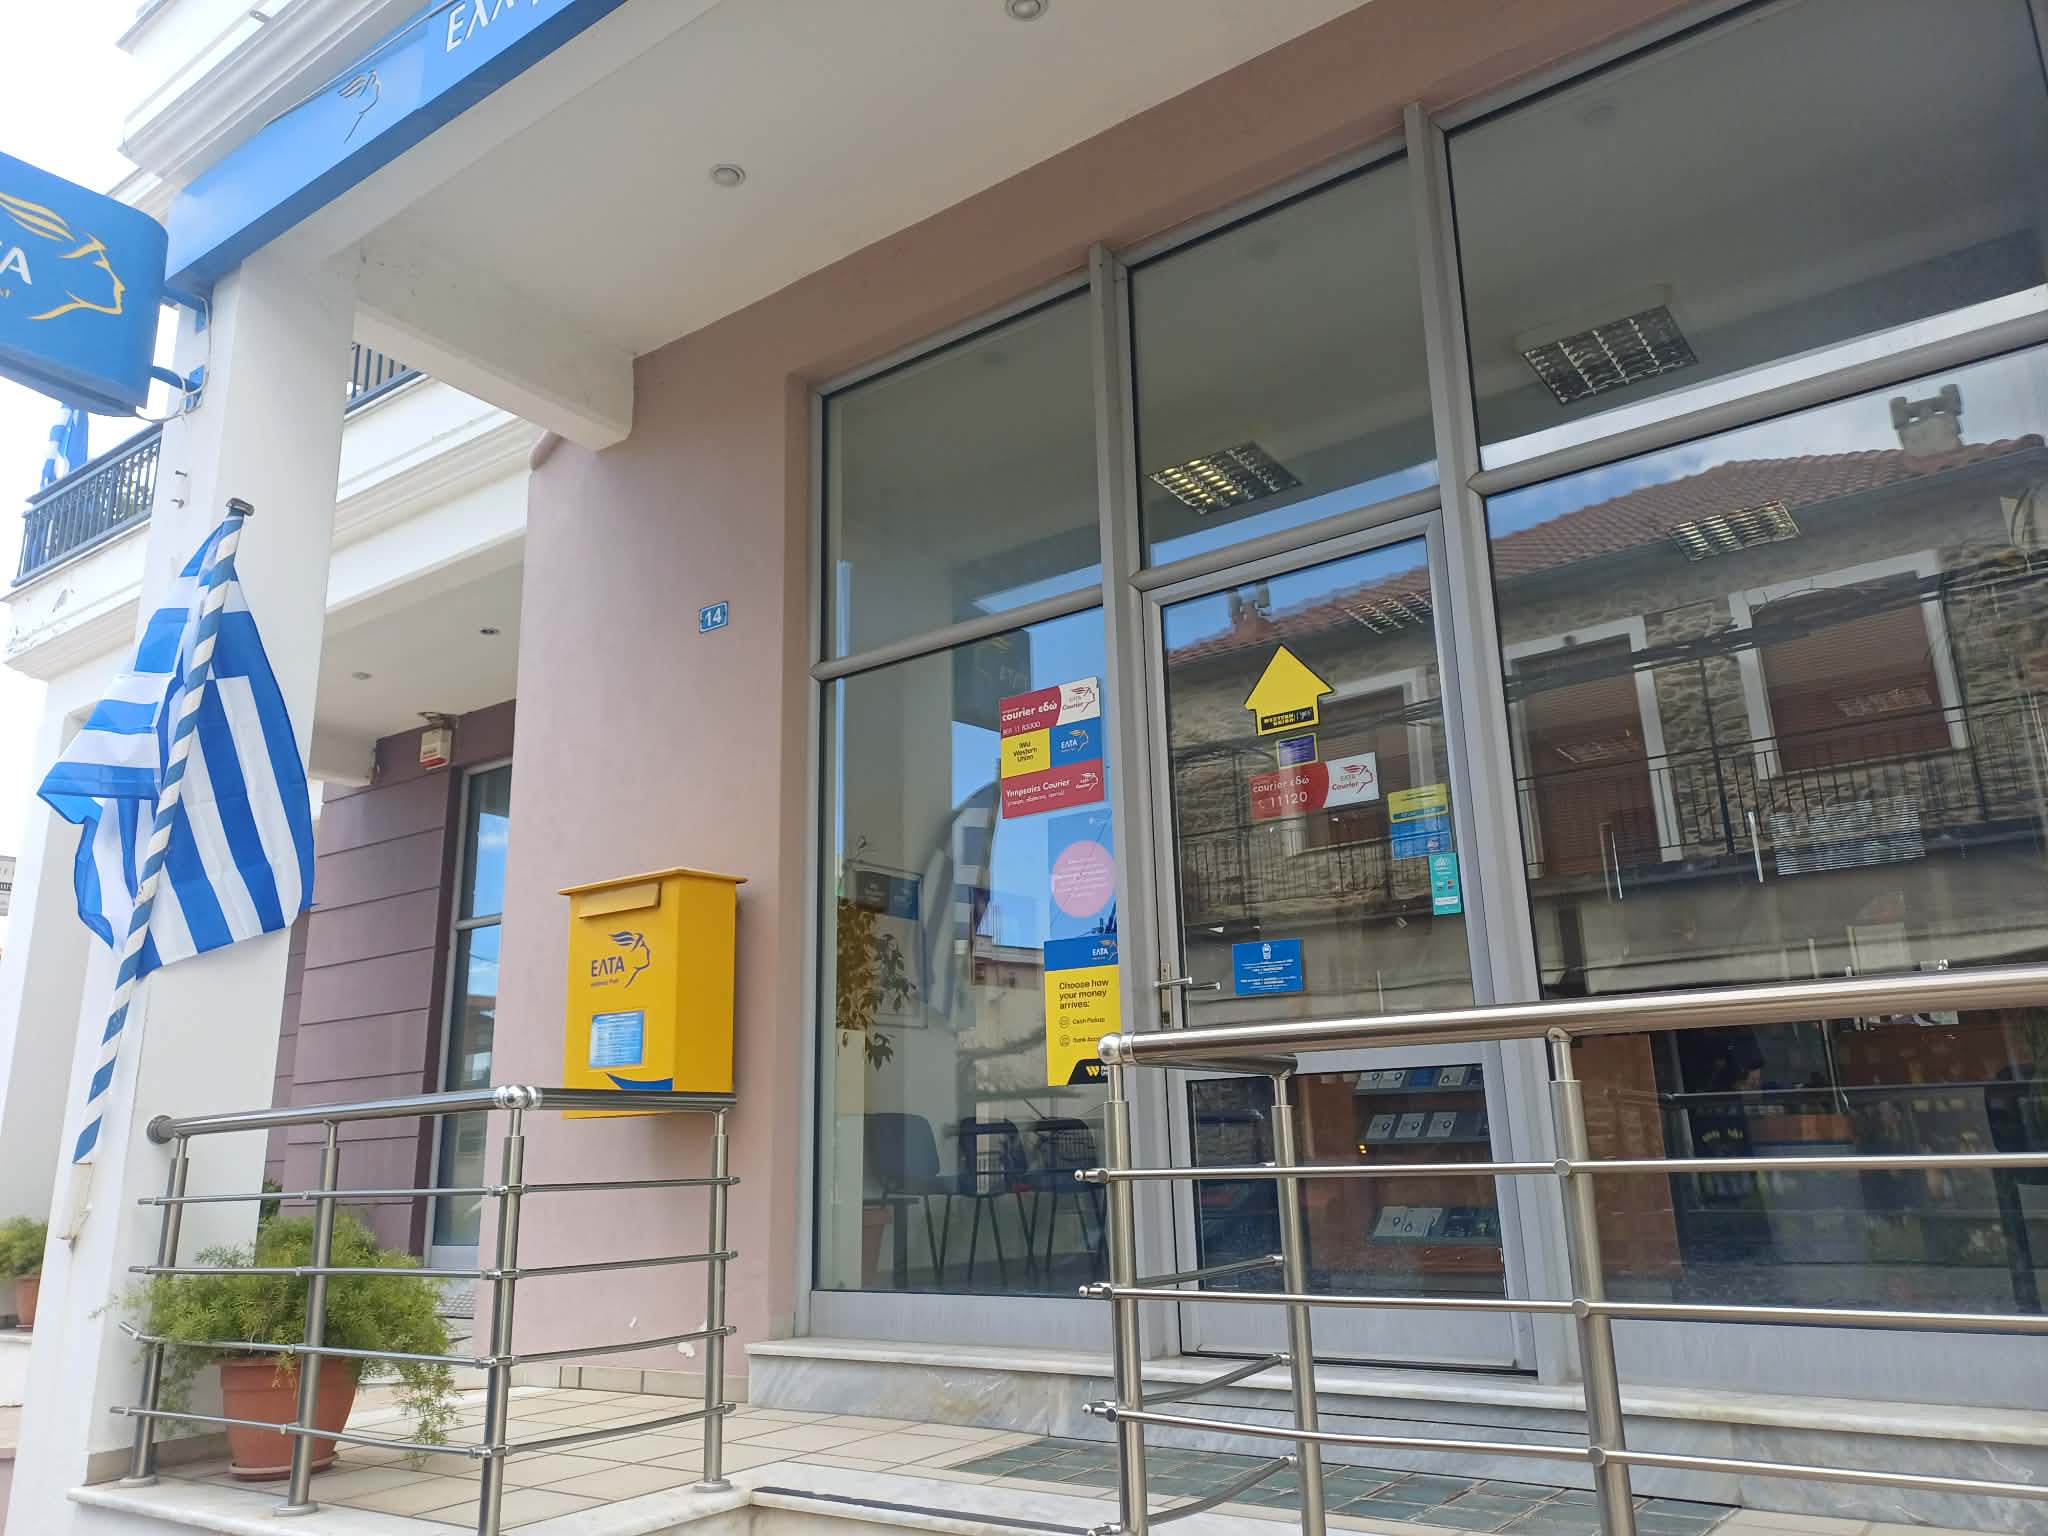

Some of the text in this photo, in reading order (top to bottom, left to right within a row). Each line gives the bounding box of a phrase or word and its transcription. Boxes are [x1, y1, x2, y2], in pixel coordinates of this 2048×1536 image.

[704, 607, 721, 627] 14
[1062, 702, 1084, 711] Courier
[1002, 709, 1036, 721] courier
[1013, 748, 1038, 757] Western
[1042, 779, 1071, 791] Courier
[1332, 780, 1359, 791] Courier
[1270, 791, 1308, 809] 11120
[591, 956, 625, 977] ΕΛΤΑ
[1059, 978, 1109, 990] Choose how
[1059, 989, 1107, 1001] your money
[1059, 1001, 1090, 1010] arrives:
